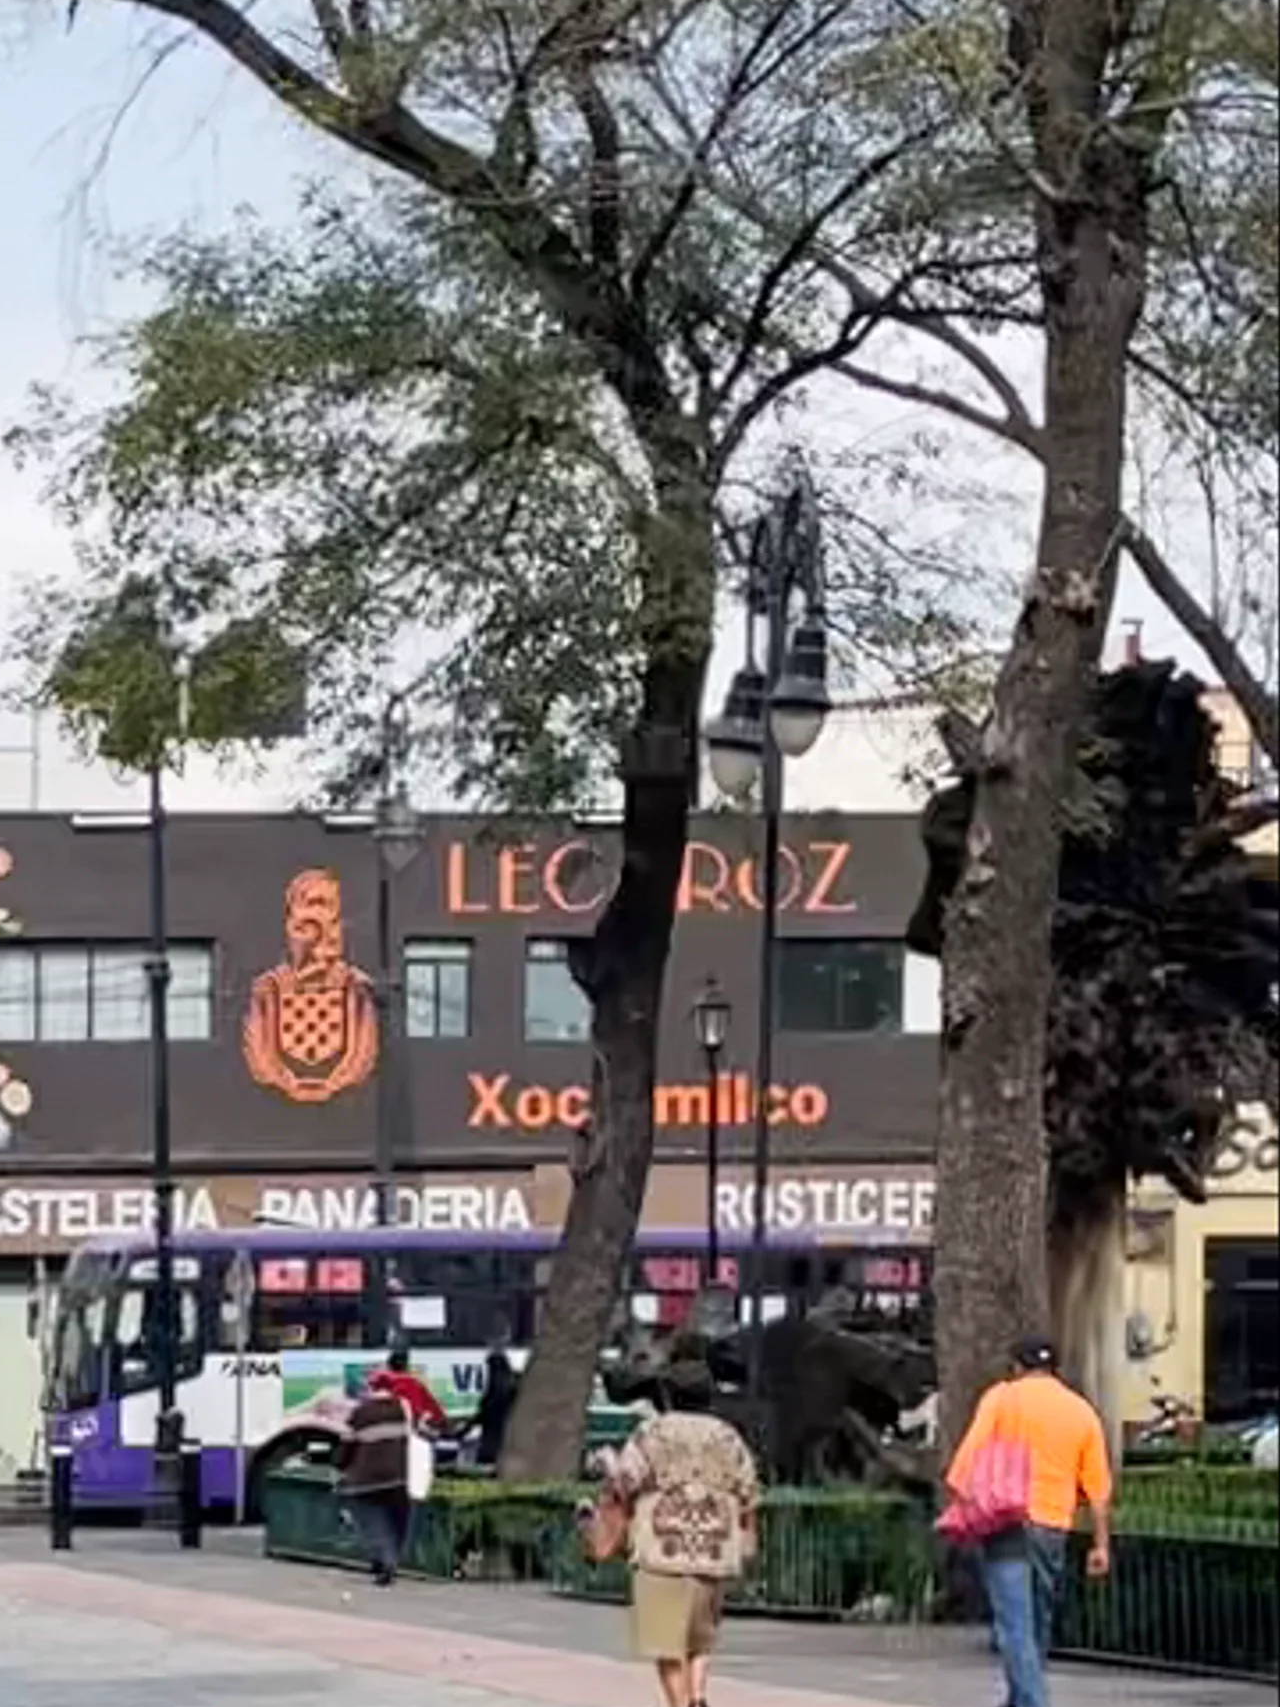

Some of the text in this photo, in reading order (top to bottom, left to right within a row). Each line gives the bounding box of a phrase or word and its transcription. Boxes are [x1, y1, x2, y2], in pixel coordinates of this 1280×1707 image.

[448, 841, 858, 913] LECROZ
[466, 1070, 829, 1127] Xocmilco
[260, 1185, 531, 1231] PANADERIA
[715, 1179, 938, 1229] ROSTICER
